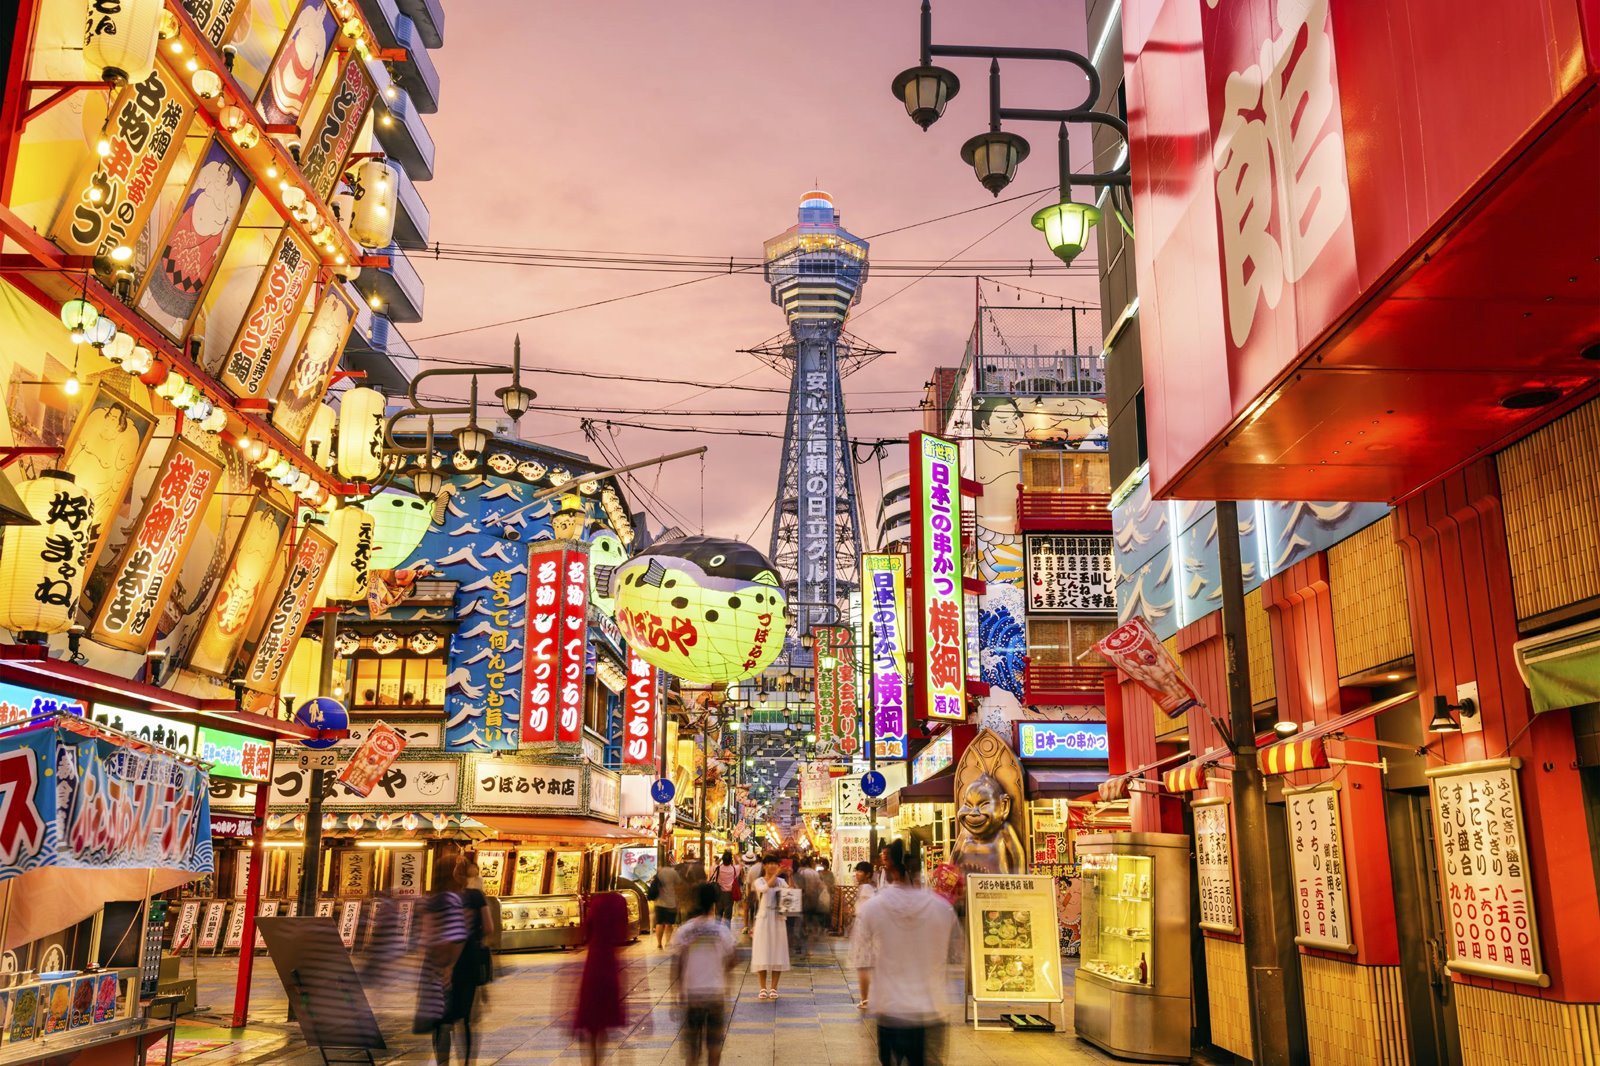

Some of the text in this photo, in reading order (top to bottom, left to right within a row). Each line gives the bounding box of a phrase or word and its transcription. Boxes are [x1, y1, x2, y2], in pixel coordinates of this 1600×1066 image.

[72, 70, 167, 245] 名物串かつ
[228, 237, 302, 385] 横綱ちゃんこ鍋
[806, 371, 828, 624] 安心と信頼の日立グループ
[924, 439, 956, 464] 新世界
[104, 453, 195, 632] 横綱巻き
[130, 471, 210, 635] 盛り沢山具材
[928, 463, 961, 692] 日本一の串かつ 横綱
[252, 537, 318, 681] 揚げたこ焼き
[618, 606, 698, 657] づぼらや
[1033, 572, 1043, 608] もち
[1045, 572, 1056, 608] うずら玉子
[1056, 572, 1068, 608] 紅しょうが
[1067, 572, 1078, 608] にんにく
[1079, 572, 1091, 608] 玉ねぎ
[1091, 572, 1102, 608] 山芋
[1103, 572, 1114, 608] しし唐
[485, 570, 513, 742] 安うて何んでも旨い
[529, 560, 556, 733] 名物 てっちり
[561, 561, 585, 733] 名物 てっちり
[868, 573, 904, 738] 日本一の串かつ 横綱
[629, 645, 651, 760] 味てっちり
[934, 695, 961, 716] 酒処
[1035, 732, 1106, 749] 日本一の串かつ
[241, 743, 272, 778] 横綱
[274, 767, 407, 799] づぼや
[481, 774, 575, 796] づぼらや本店
[1292, 800, 1305, 852] てっさ
[1307, 798, 1321, 871] てっちり
[1439, 785, 1467, 957] にぎりずし 九〇〇円
[1452, 783, 1482, 959] すし盛合 九〇〇円
[1469, 781, 1487, 875] 上にぎり
[1482, 780, 1514, 963] ふぐにぎり 八五〇円
[1497, 777, 1521, 877] ふぐにぎり盛合
